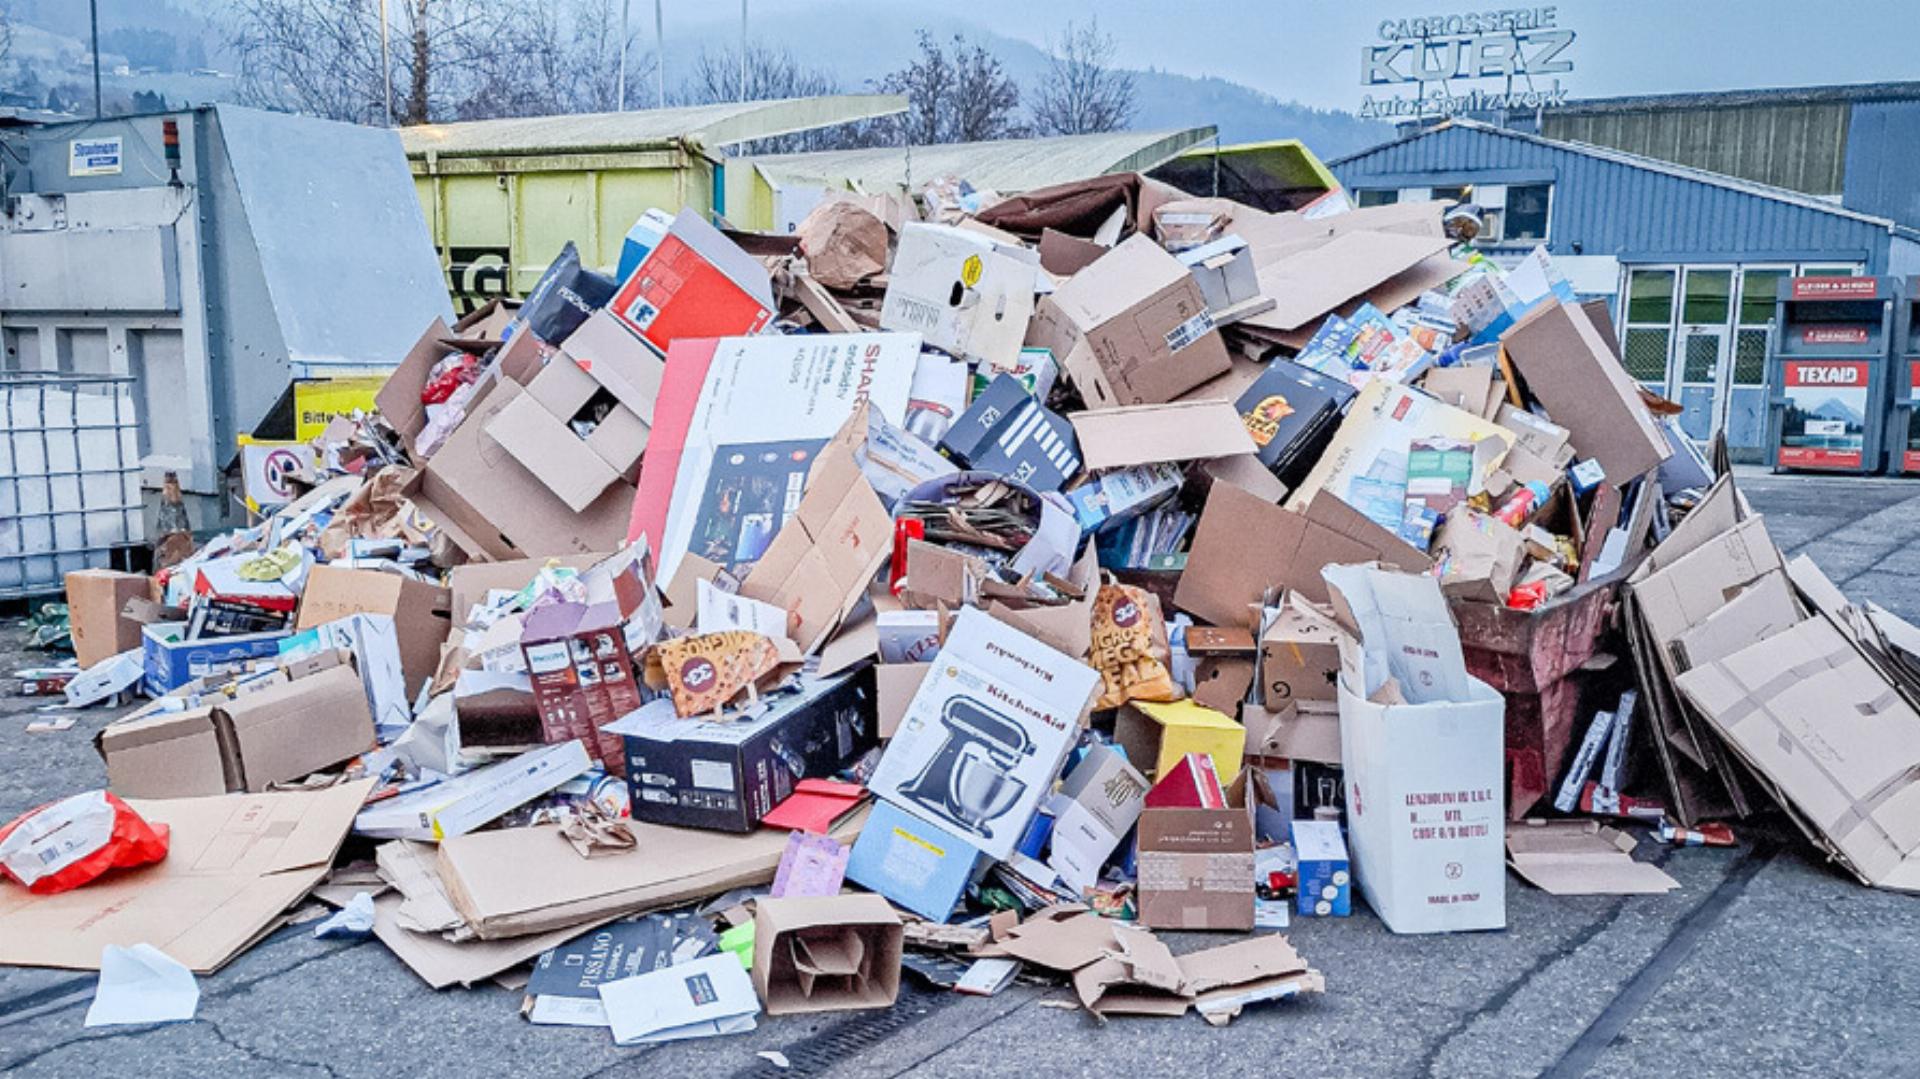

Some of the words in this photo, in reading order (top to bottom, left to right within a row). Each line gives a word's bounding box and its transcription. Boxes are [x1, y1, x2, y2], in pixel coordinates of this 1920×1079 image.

[1377, 6, 1557, 41] CARROSSERIE
[1361, 30, 1576, 85] KURZ
[852, 344, 881, 411] SHAR
[1797, 367, 1858, 383] TEXAID
[985, 641, 1055, 682] KitchenAid
[986, 683, 1067, 731] KitchenAid
